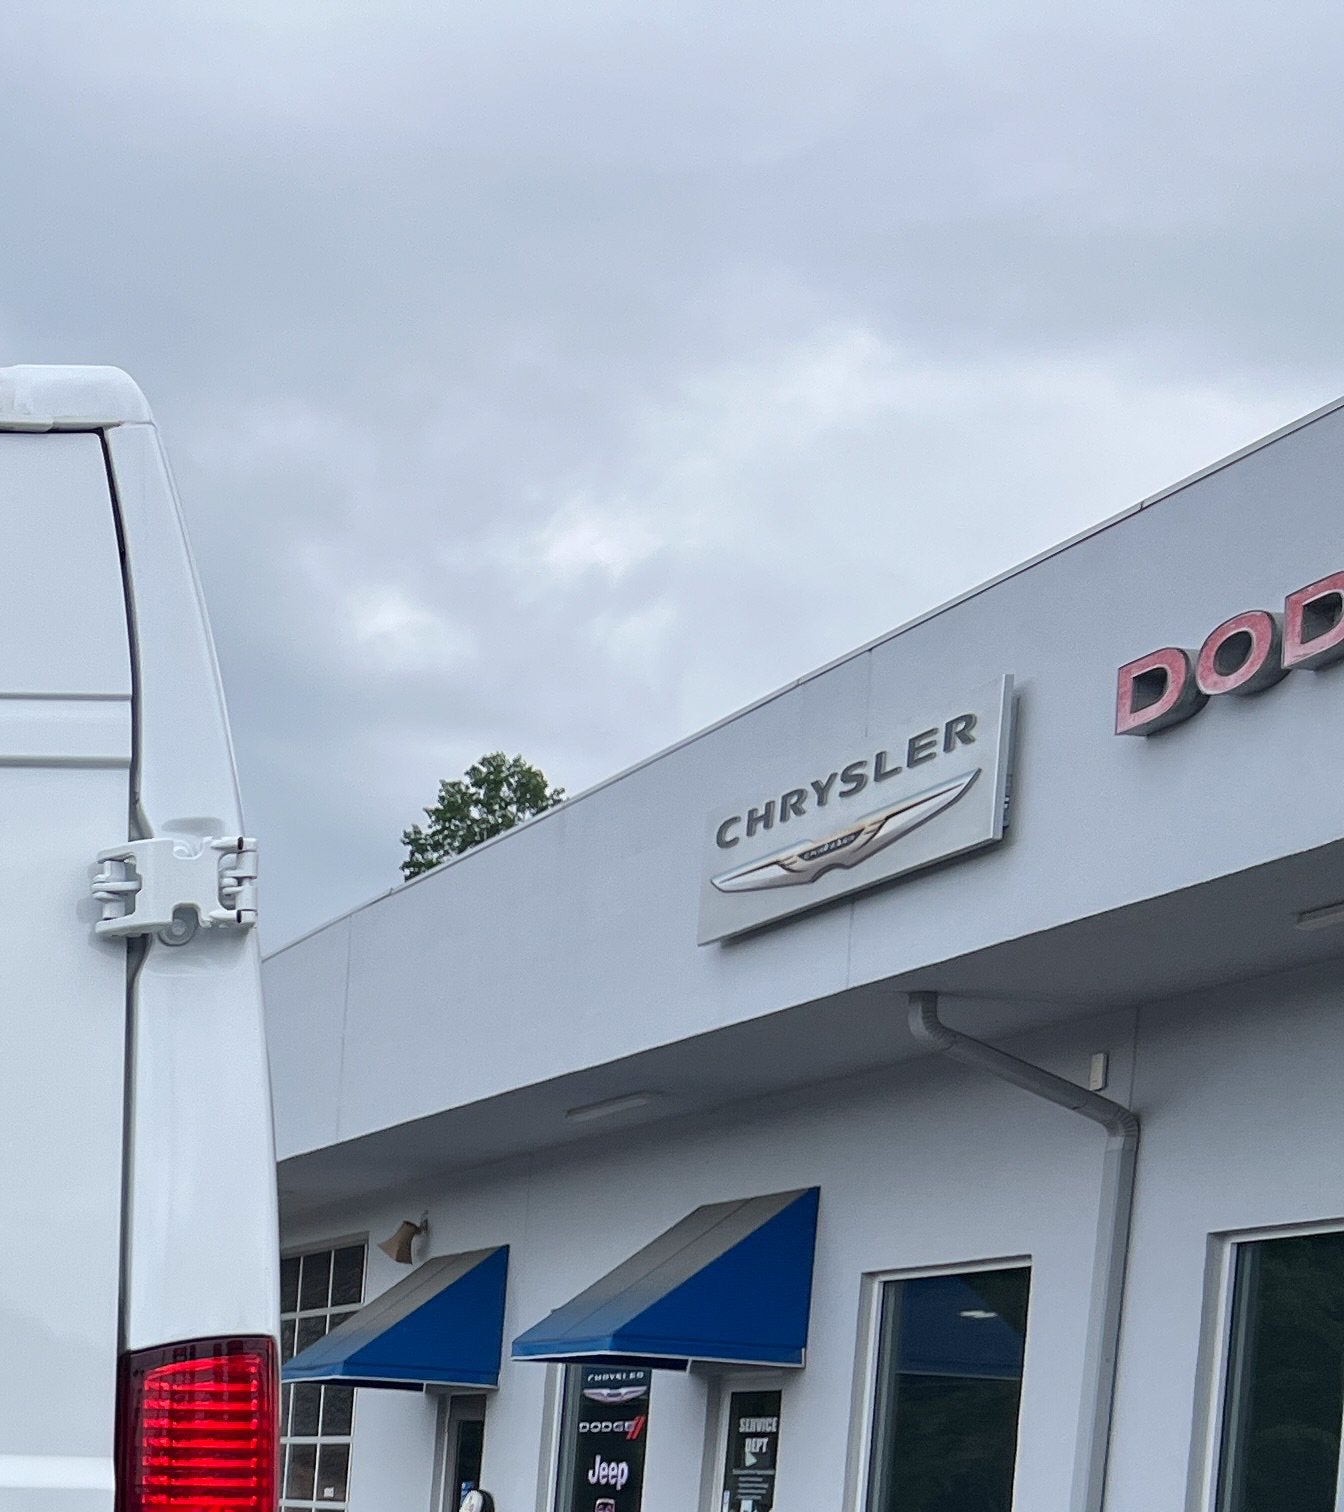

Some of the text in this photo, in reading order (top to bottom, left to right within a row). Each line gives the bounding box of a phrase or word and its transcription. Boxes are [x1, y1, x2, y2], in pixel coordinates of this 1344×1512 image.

[1114, 570, 1344, 736] DOD
[715, 712, 978, 850] CHRYSLER
[578, 1420, 635, 1433] DODGE
[738, 1416, 778, 1433] SERVICE
[744, 1437, 769, 1453] DEPT
[587, 1454, 629, 1491] Jeep
